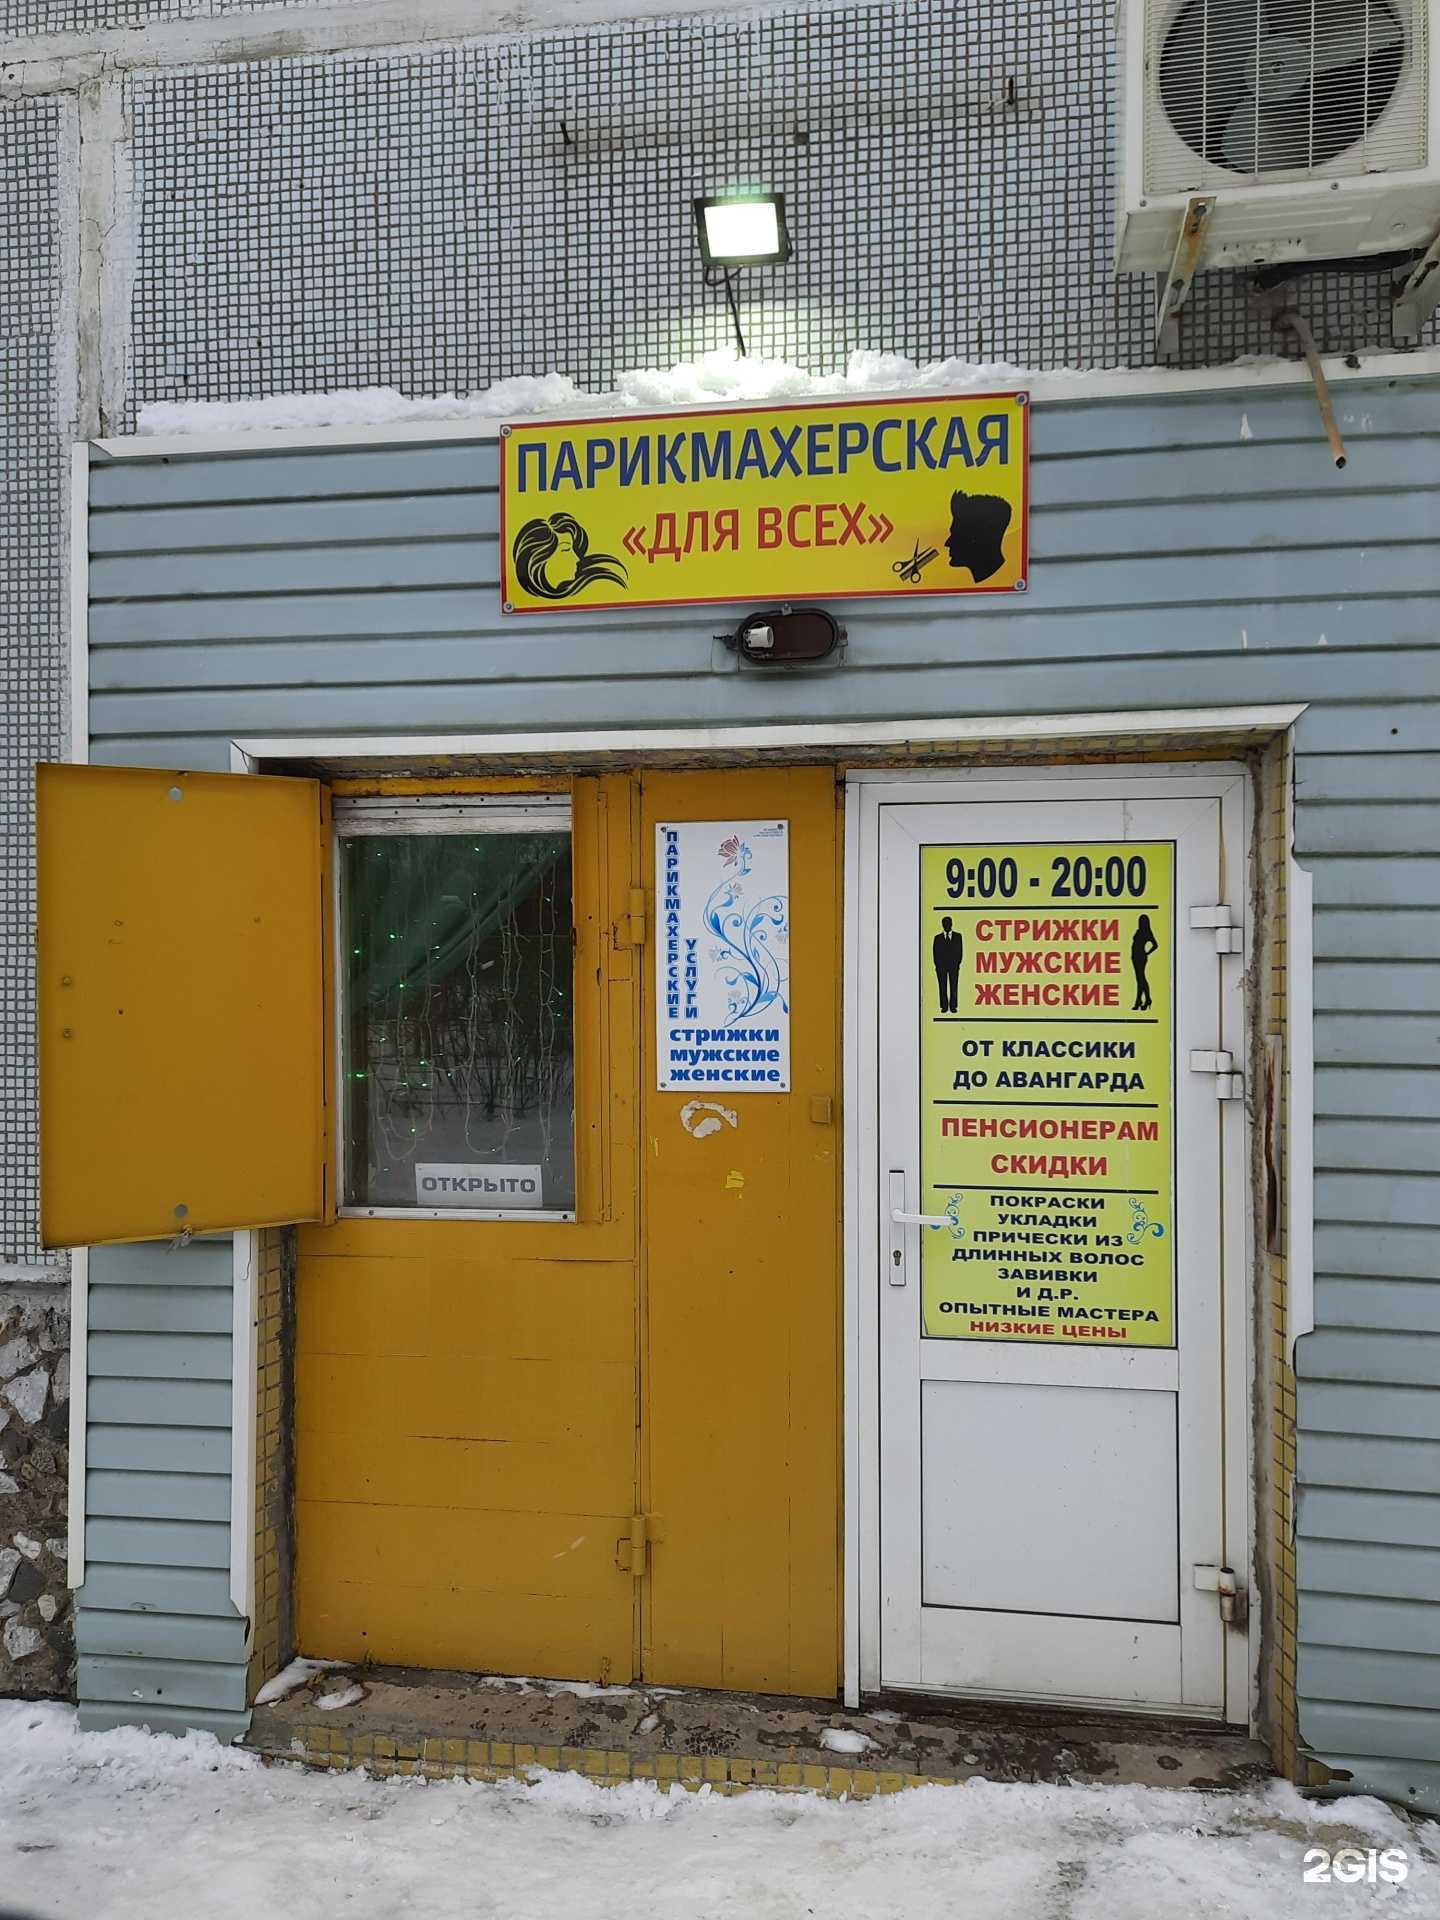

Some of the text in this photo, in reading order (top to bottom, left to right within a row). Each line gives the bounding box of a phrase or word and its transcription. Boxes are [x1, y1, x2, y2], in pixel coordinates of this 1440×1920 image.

[517, 413, 1010, 493] ПАРИКМАХЕРСКАЯ
[622, 501, 894, 564] «ДЛЯ ВСЕХ»
[946, 856, 1147, 899] 9:00 - 20:00
[665, 831, 681, 1018] ПАРИКМАХЕРСКИЕ
[975, 919, 1120, 941] СТРИЖКИ
[975, 951, 1121, 974] МУЖСКИЕ
[685, 938, 698, 1018] УСЛУГИ
[974, 983, 1120, 1006] ЖЕНСКИЕ
[961, 1040, 1136, 1059] ОТ КЛАССИКИ
[953, 1070, 1145, 1092] ДО АВАНГАРДА
[941, 1117, 1159, 1141] ПЕНСИОНЕРАМ
[991, 1154, 1108, 1178] СКИДКИ
[421, 1176, 536, 1193] ОТКРЫТО
[990, 1195, 1105, 1209] ПОКРАСКИ
[997, 1213, 1097, 1228] УКЛАДКИ
[973, 1231, 1124, 1247] ПРИЧЕСКИ ИЗ
[952, 1249, 1145, 1266] ДЛИННЫХ ВОЛОС
[997, 1268, 1098, 1283] ЗАВИВКИ
[1016, 1287, 1079, 1300] И Д.Р.
[939, 1302, 1160, 1322] ОПЫТНЫЕ МАСТЕРА
[970, 1321, 1127, 1339] НИЗКИЕ ЦЕНЫ
